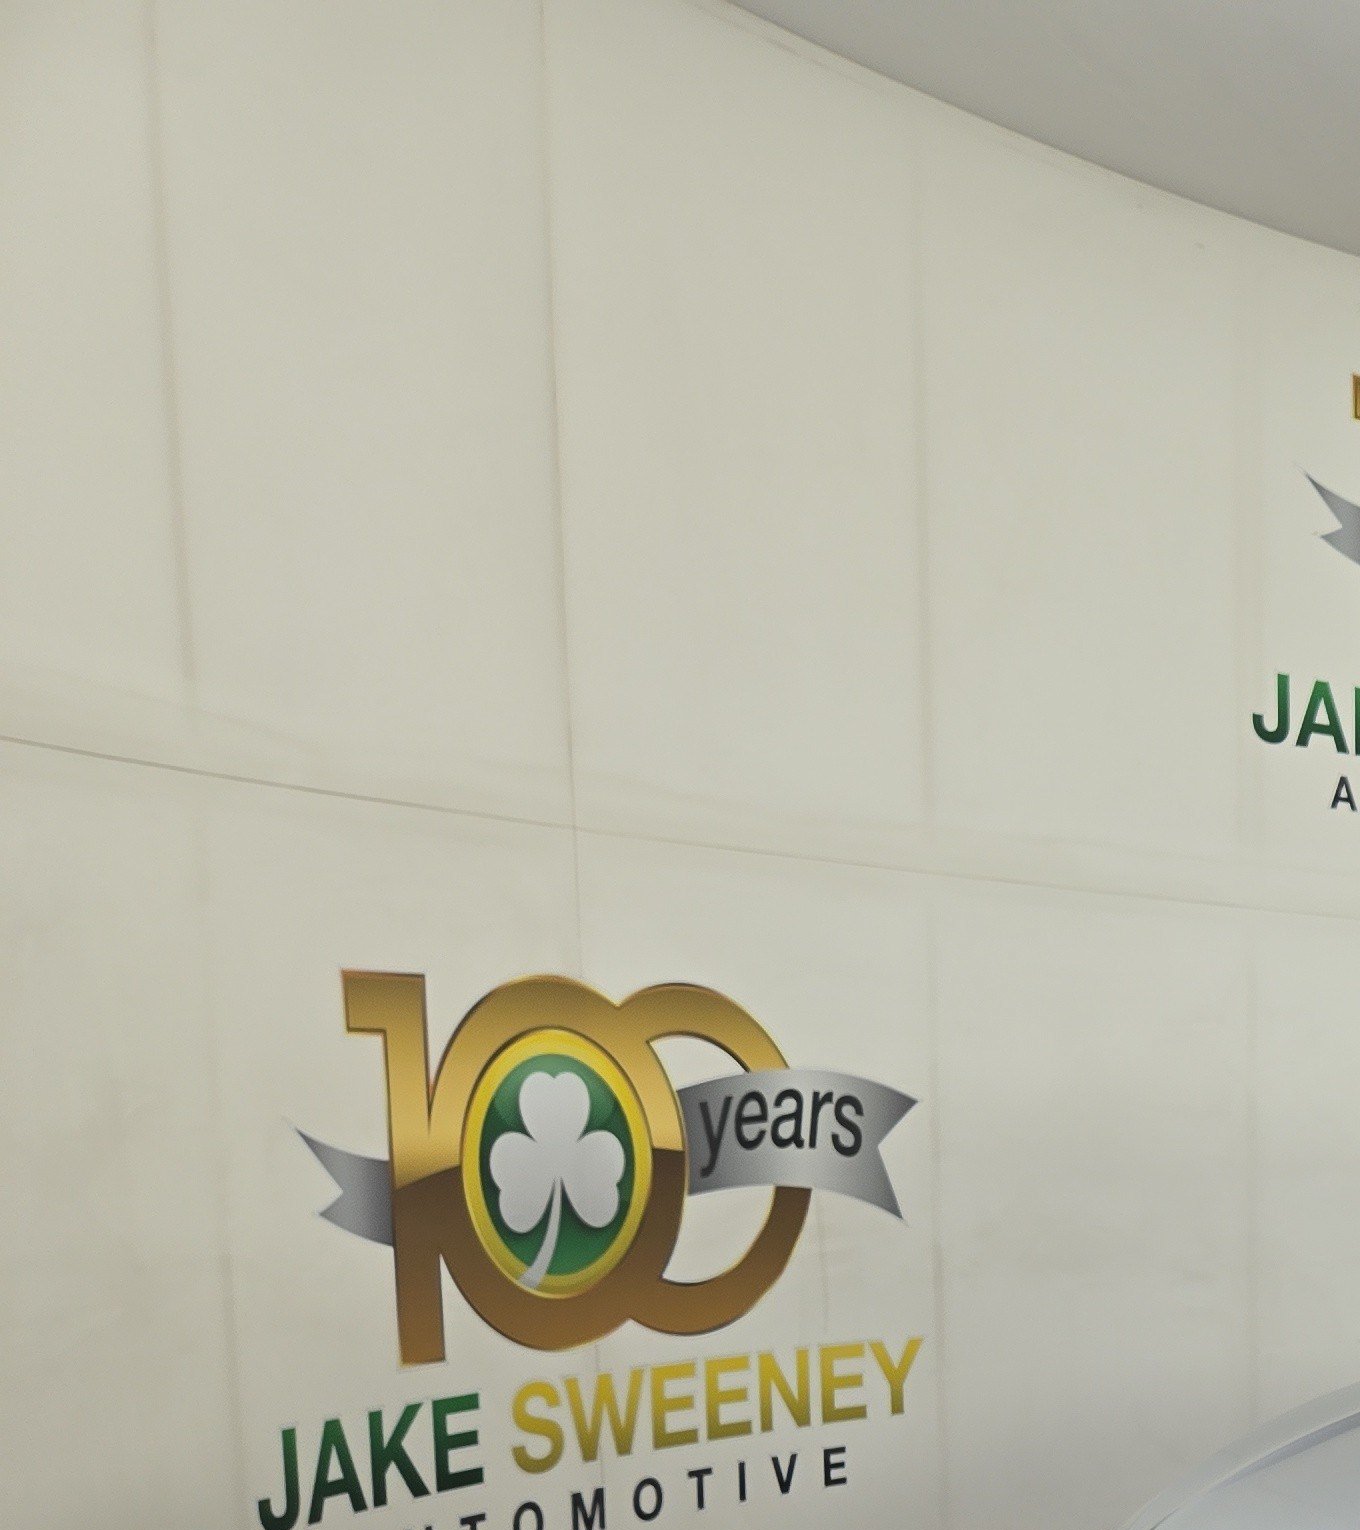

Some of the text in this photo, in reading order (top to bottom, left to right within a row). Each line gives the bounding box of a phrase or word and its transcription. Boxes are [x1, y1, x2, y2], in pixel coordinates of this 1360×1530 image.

[340, 969, 864, 1366] 100 years
[511, 1336, 924, 1474] SWEENEY
